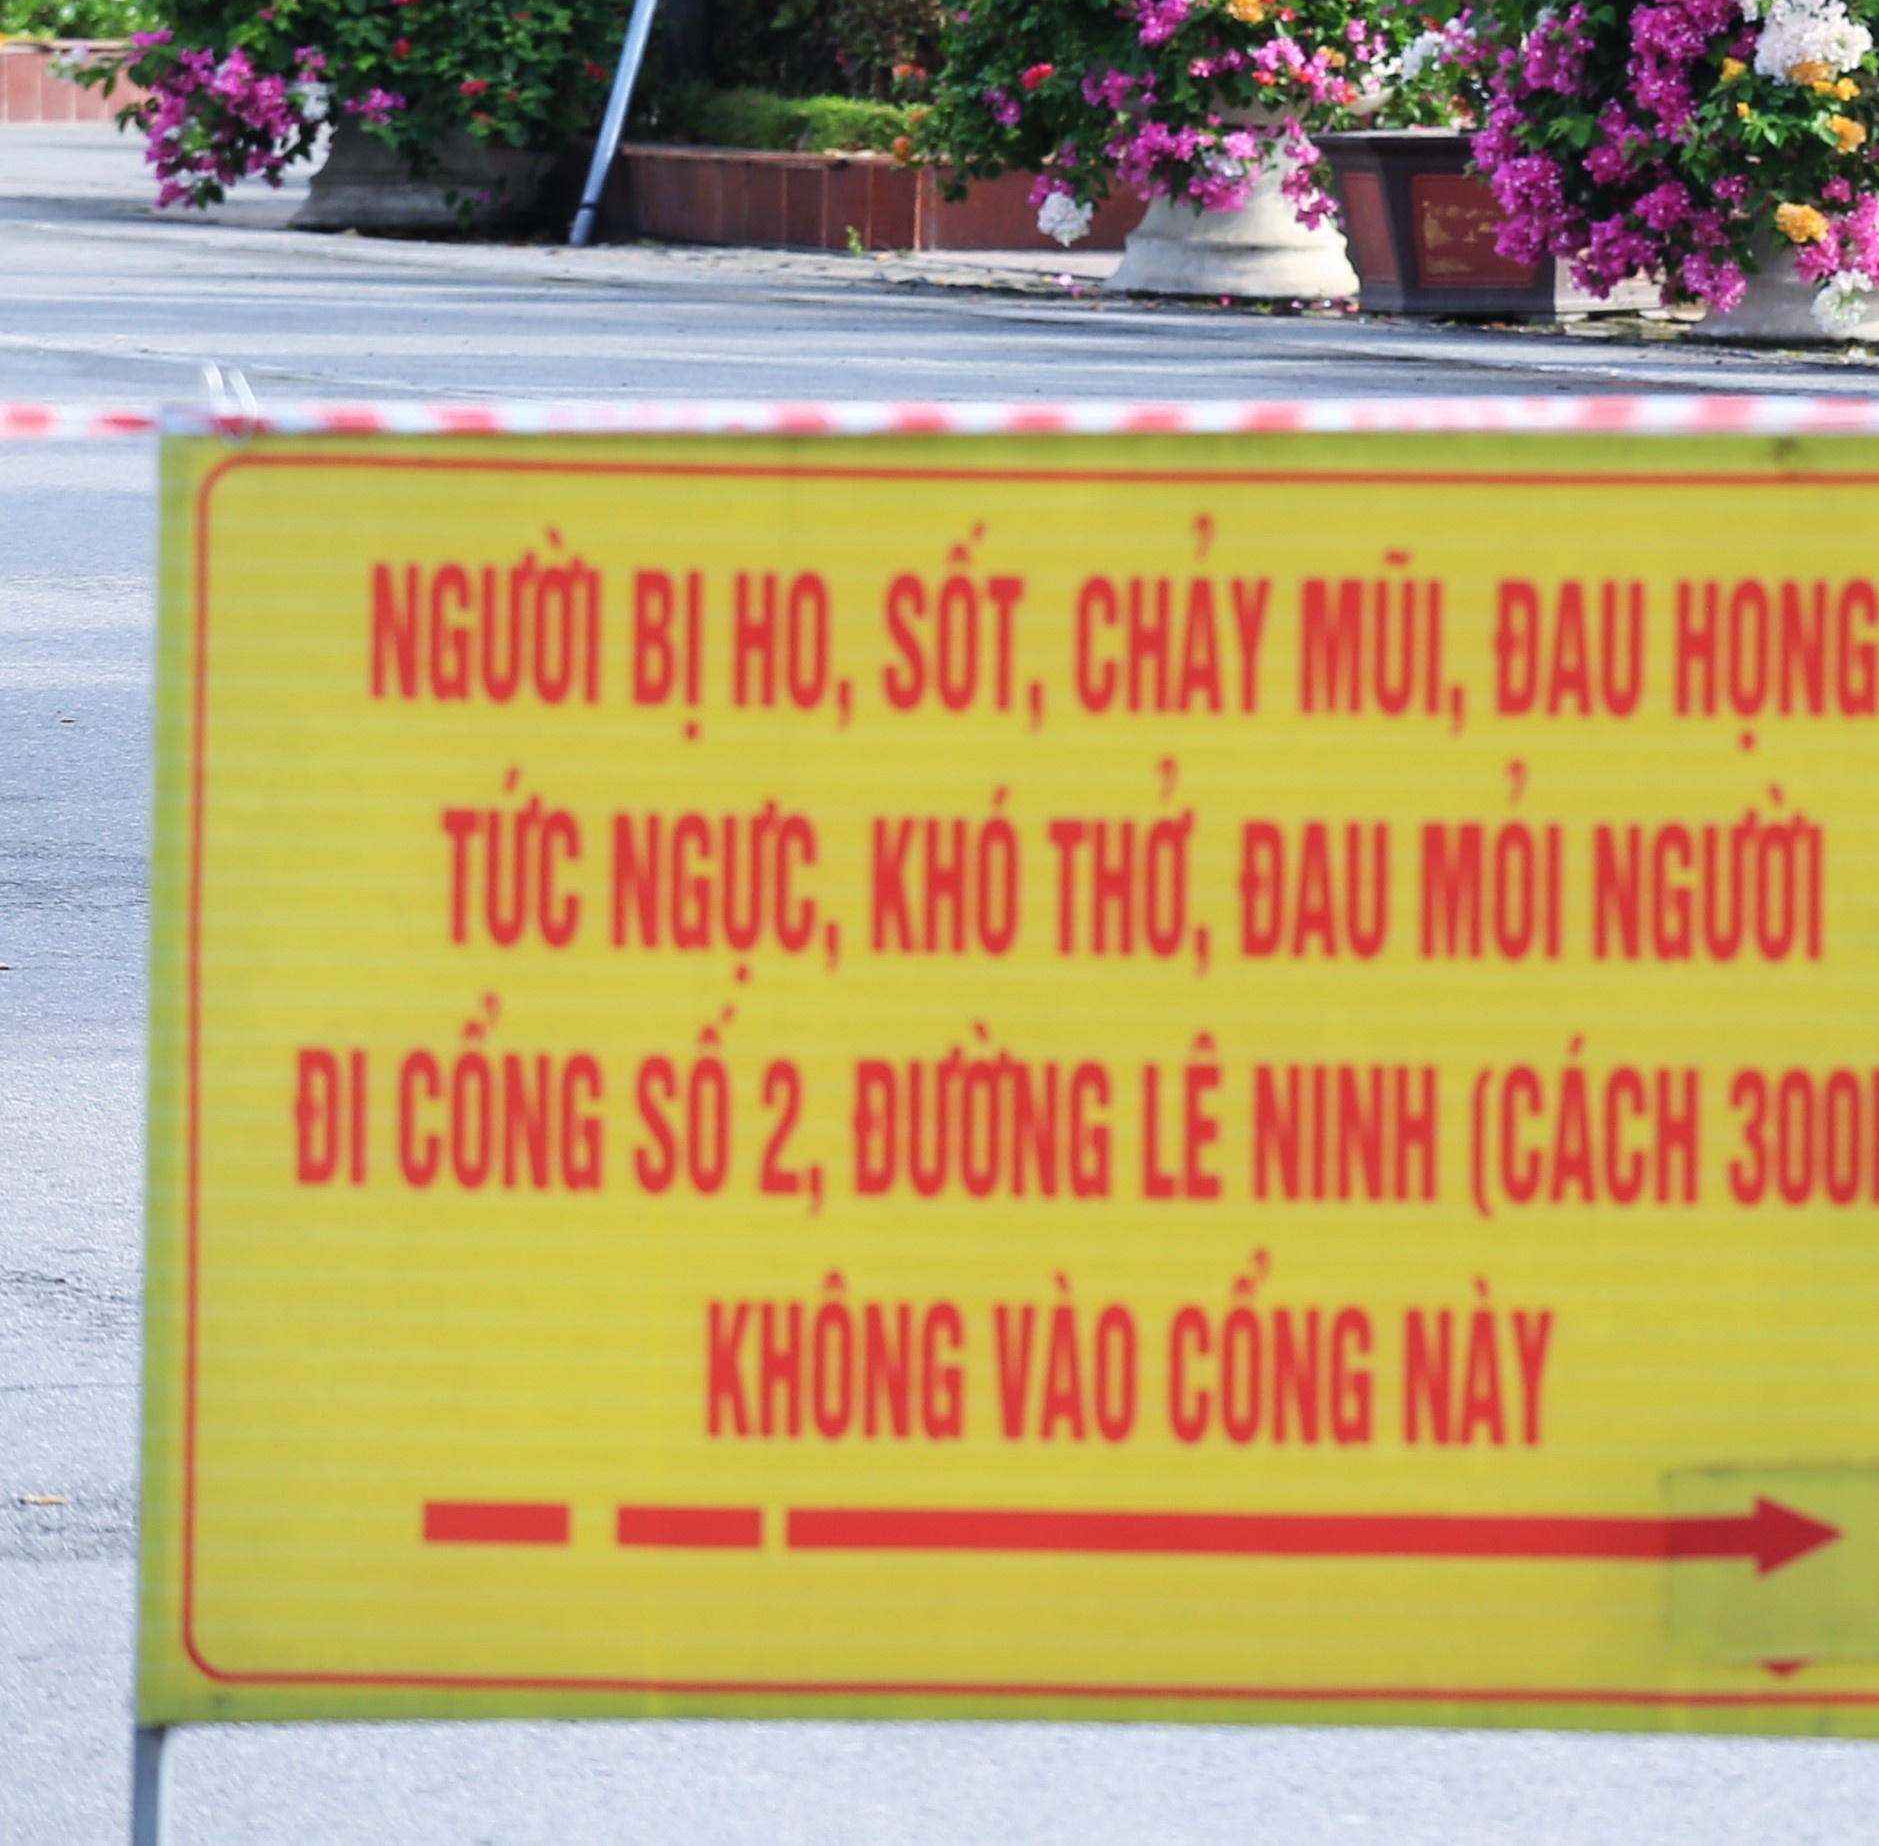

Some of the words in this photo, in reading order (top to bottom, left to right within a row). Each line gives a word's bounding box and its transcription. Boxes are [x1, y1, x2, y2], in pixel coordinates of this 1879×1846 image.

[370, 528, 603, 706] NGƯỜI
[631, 569, 704, 741] BỊ
[731, 570, 853, 722] HO,
[882, 521, 1045, 723] SỐT,
[1074, 514, 1272, 715] CHẢY
[1299, 550, 1466, 729] MŨI,
[1492, 578, 1646, 720] ĐAU
[441, 765, 582, 950] TỨC
[610, 799, 841, 983] NGỰC,
[870, 787, 1021, 958] KHÓ
[1047, 757, 1210, 968] THỞ,
[1237, 819, 1391, 961] ĐAU
[1419, 760, 1564, 962] MỎI
[1592, 784, 1824, 963] NGƯỜI
[293, 1047, 368, 1186] ĐI
[397, 992, 604, 1193] CỔNG
[633, 1004, 732, 1196] SỐ
[758, 1058, 825, 1206] 2,
[851, 1022, 1113, 1201] ĐƯỜNG
[1141, 1032, 1223, 1202] LÊ
[1252, 1063, 1439, 1203] NINH
[1470, 1036, 1701, 1217] (CÁCH
[706, 1270, 966, 1442] KHÔNG
[991, 1274, 1140, 1445] VÀO
[1166, 1248, 1375, 1447] CỔNG
[1402, 1279, 1554, 1447] NÀY
